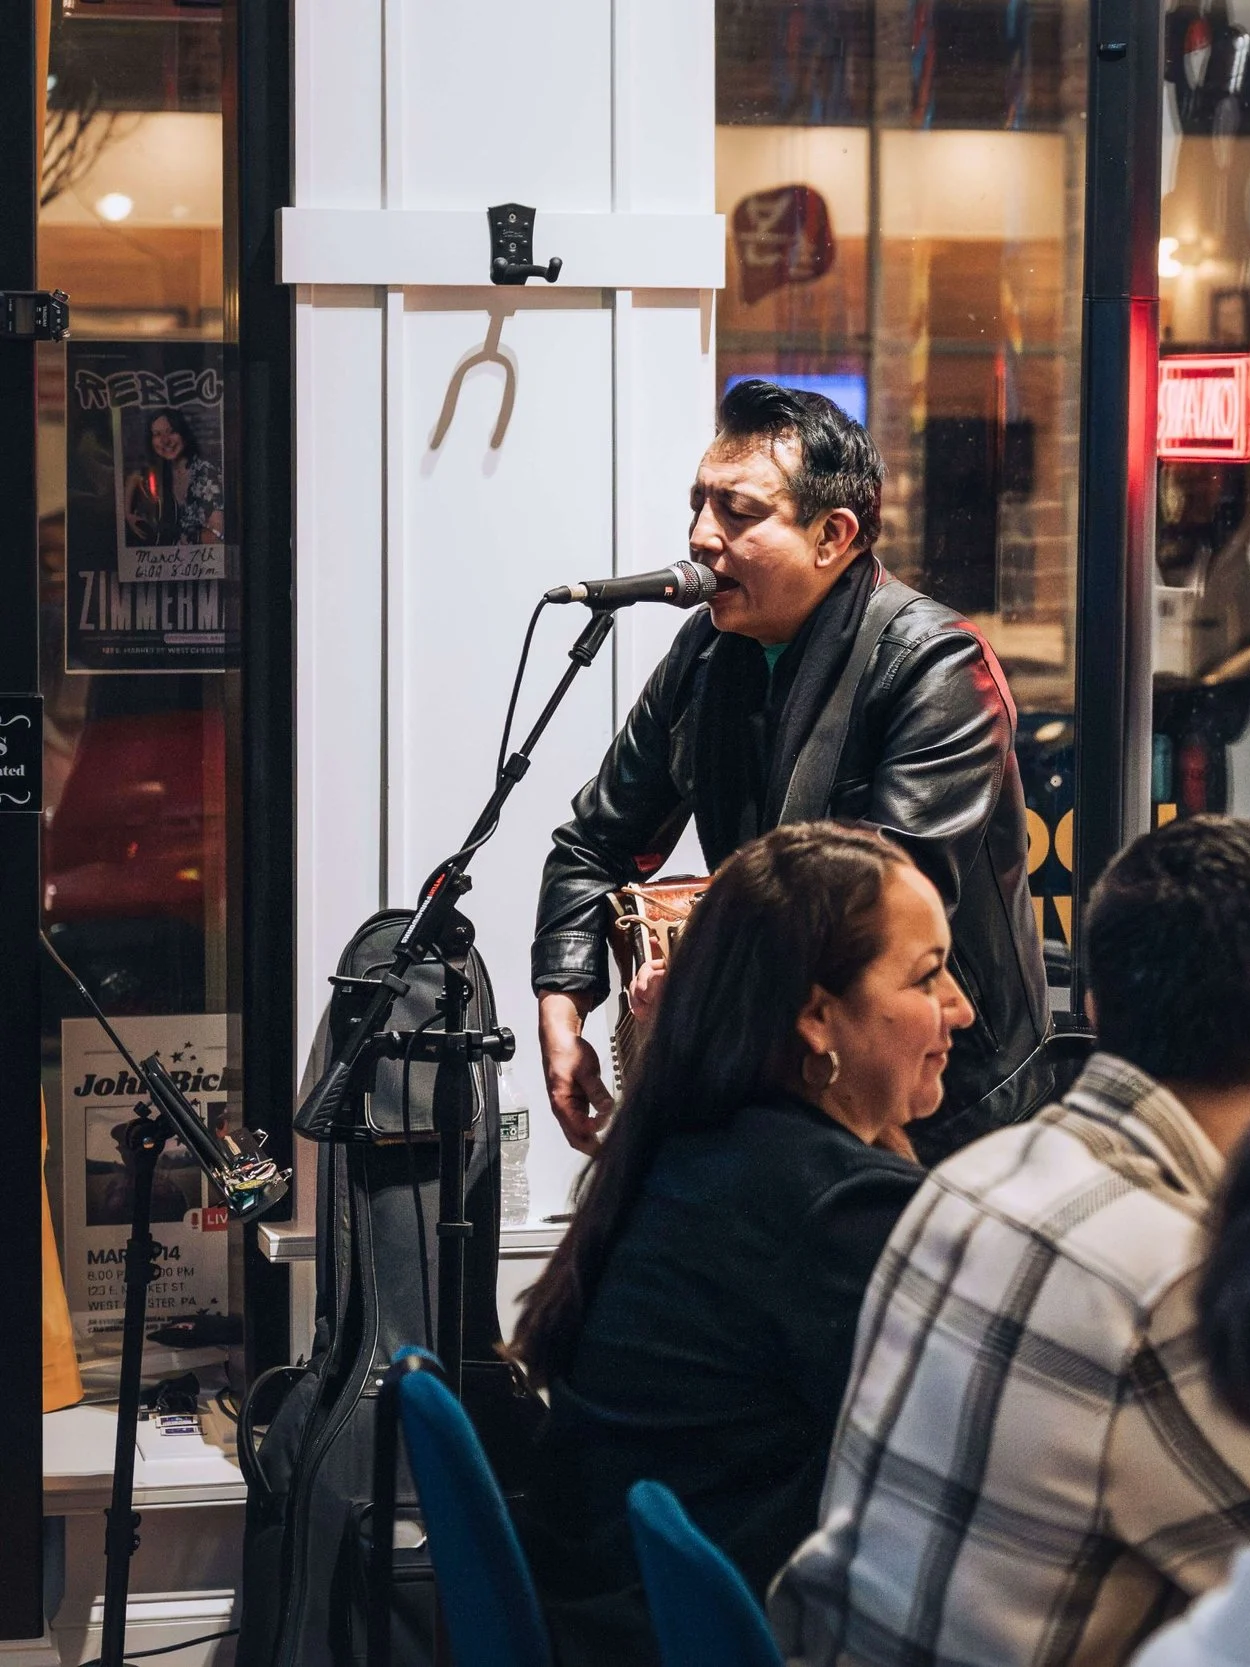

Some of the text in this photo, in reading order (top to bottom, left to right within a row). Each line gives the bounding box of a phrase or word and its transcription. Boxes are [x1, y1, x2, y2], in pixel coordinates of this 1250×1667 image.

[135, 548, 183, 563] March
[79, 571, 225, 630] ZIMMERM
[163, 1246, 181, 1261] 14
[177, 1266, 195, 1278] PM
[88, 1285, 106, 1296] 123
[171, 1282, 185, 1292] ST
[88, 1299, 120, 1311] WEST
[181, 1296, 197, 1306] PA
